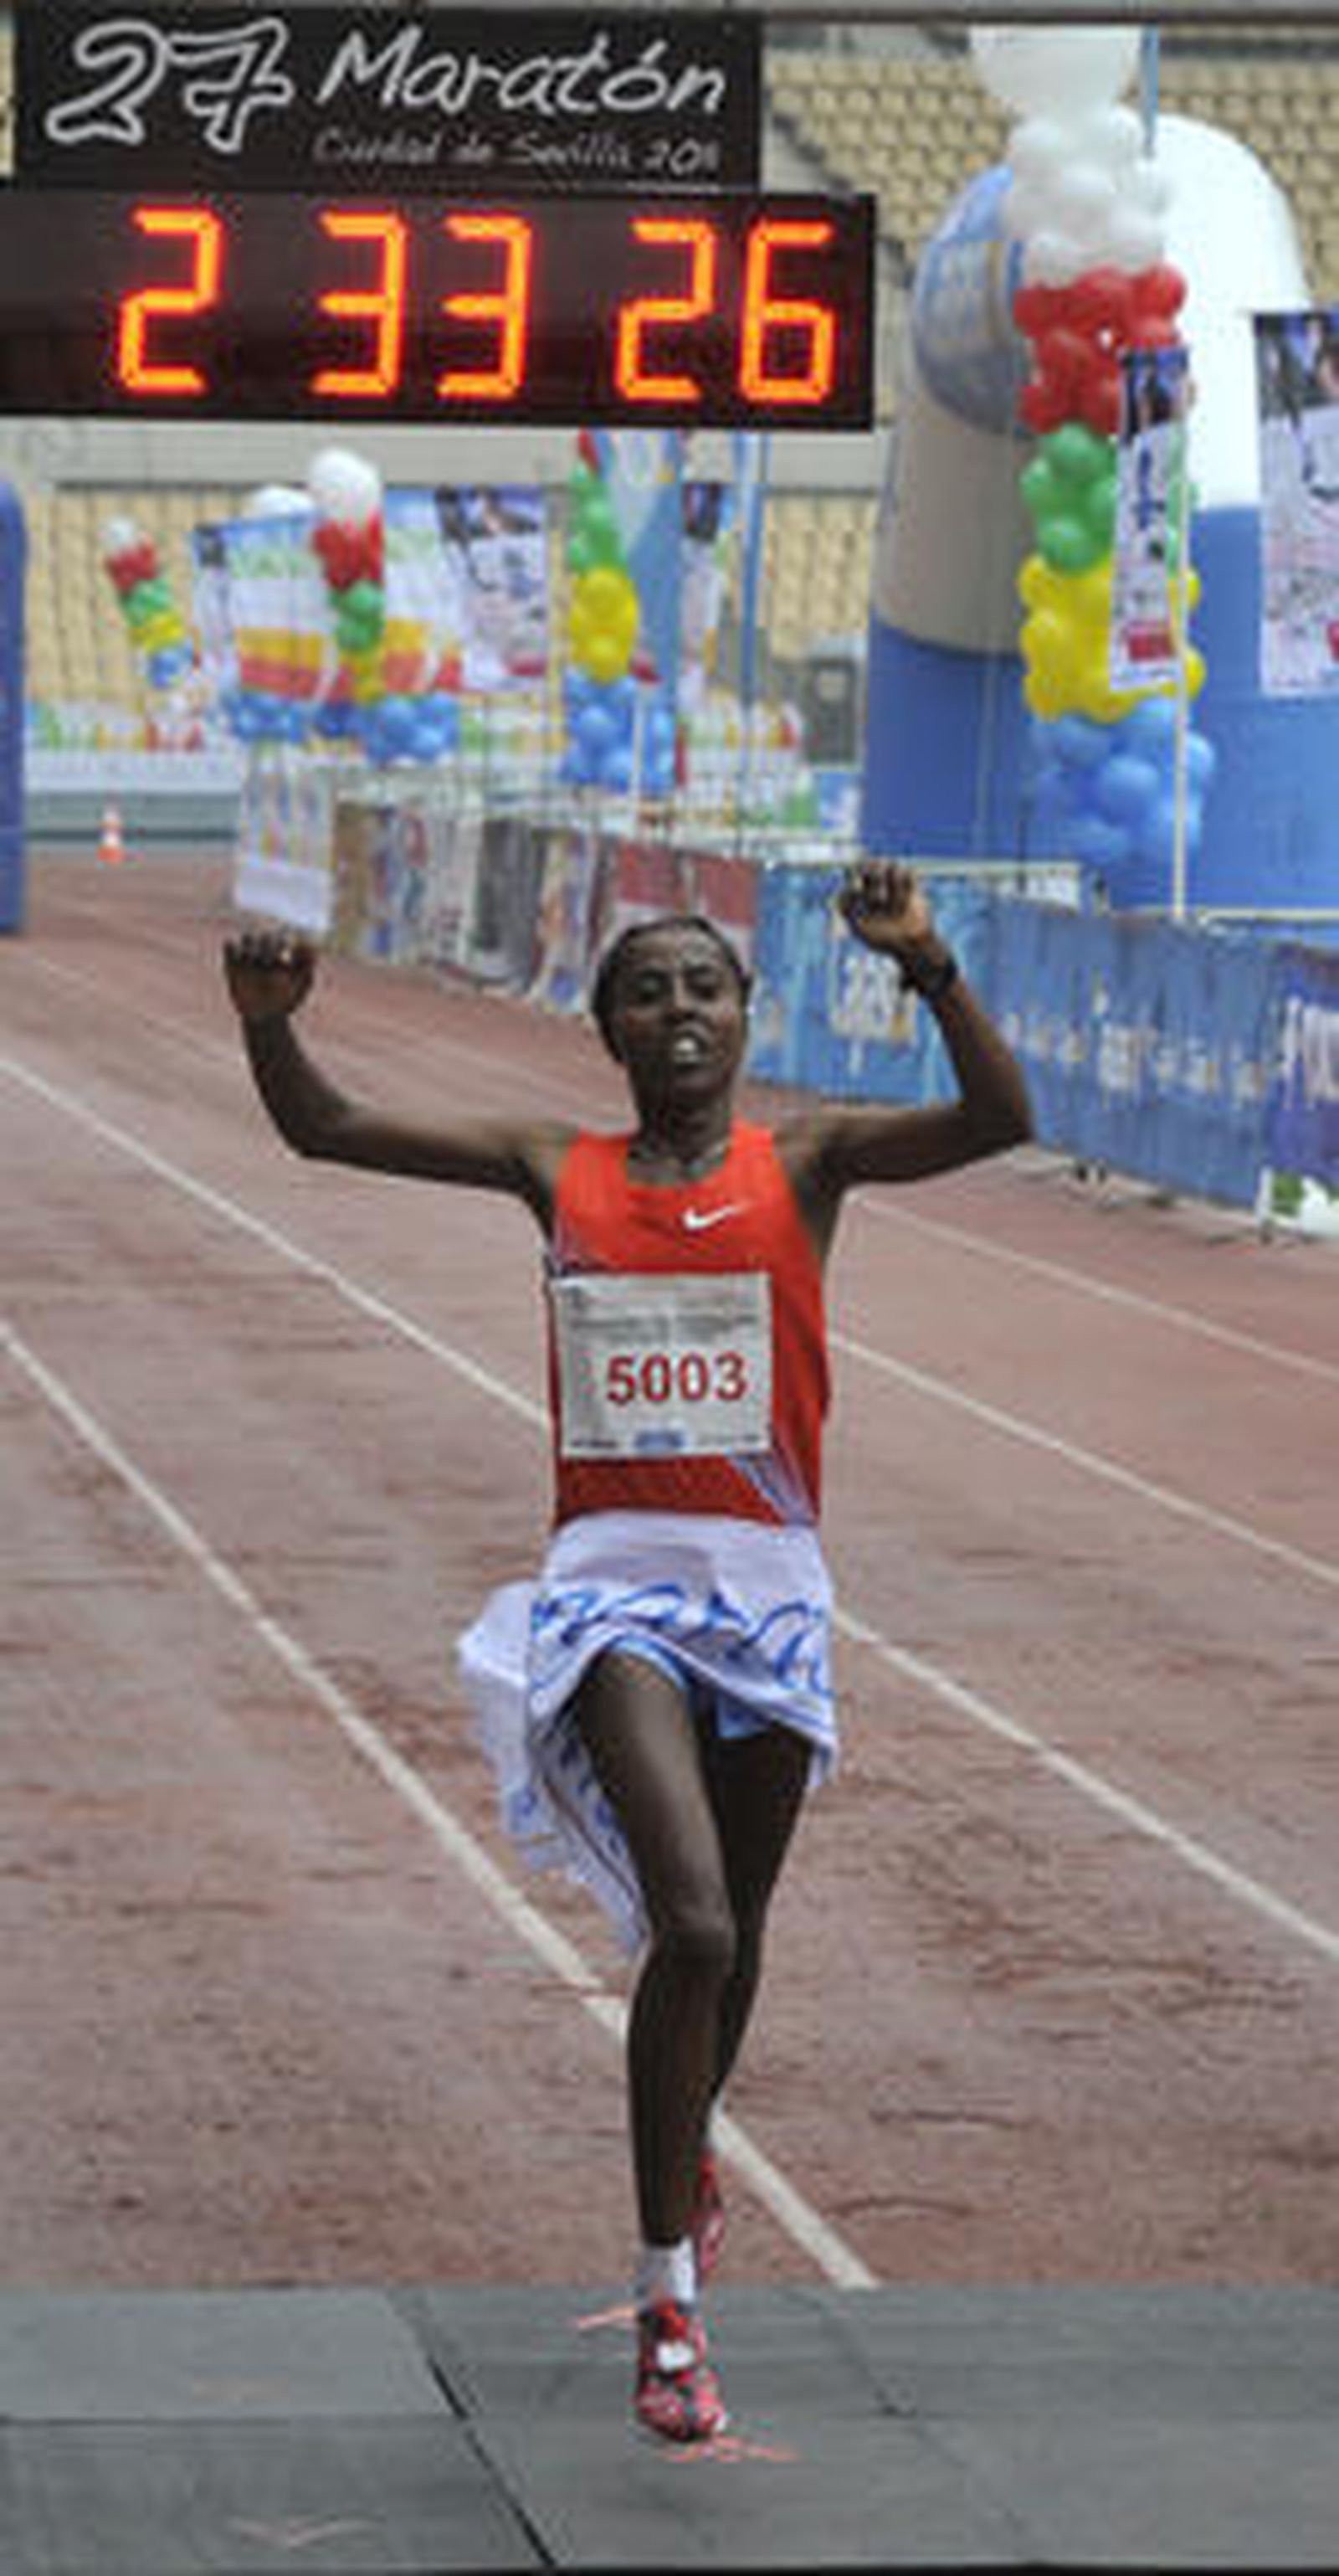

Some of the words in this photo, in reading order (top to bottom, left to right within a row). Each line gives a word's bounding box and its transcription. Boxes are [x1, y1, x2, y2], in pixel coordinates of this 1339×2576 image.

[44, 17, 295, 153] 27
[315, 25, 726, 115] Maratón
[505, 130, 632, 169] Sevilla
[116, 206, 224, 397] 2
[613, 216, 835, 404] 26
[604, 1349, 750, 1407] 5003
